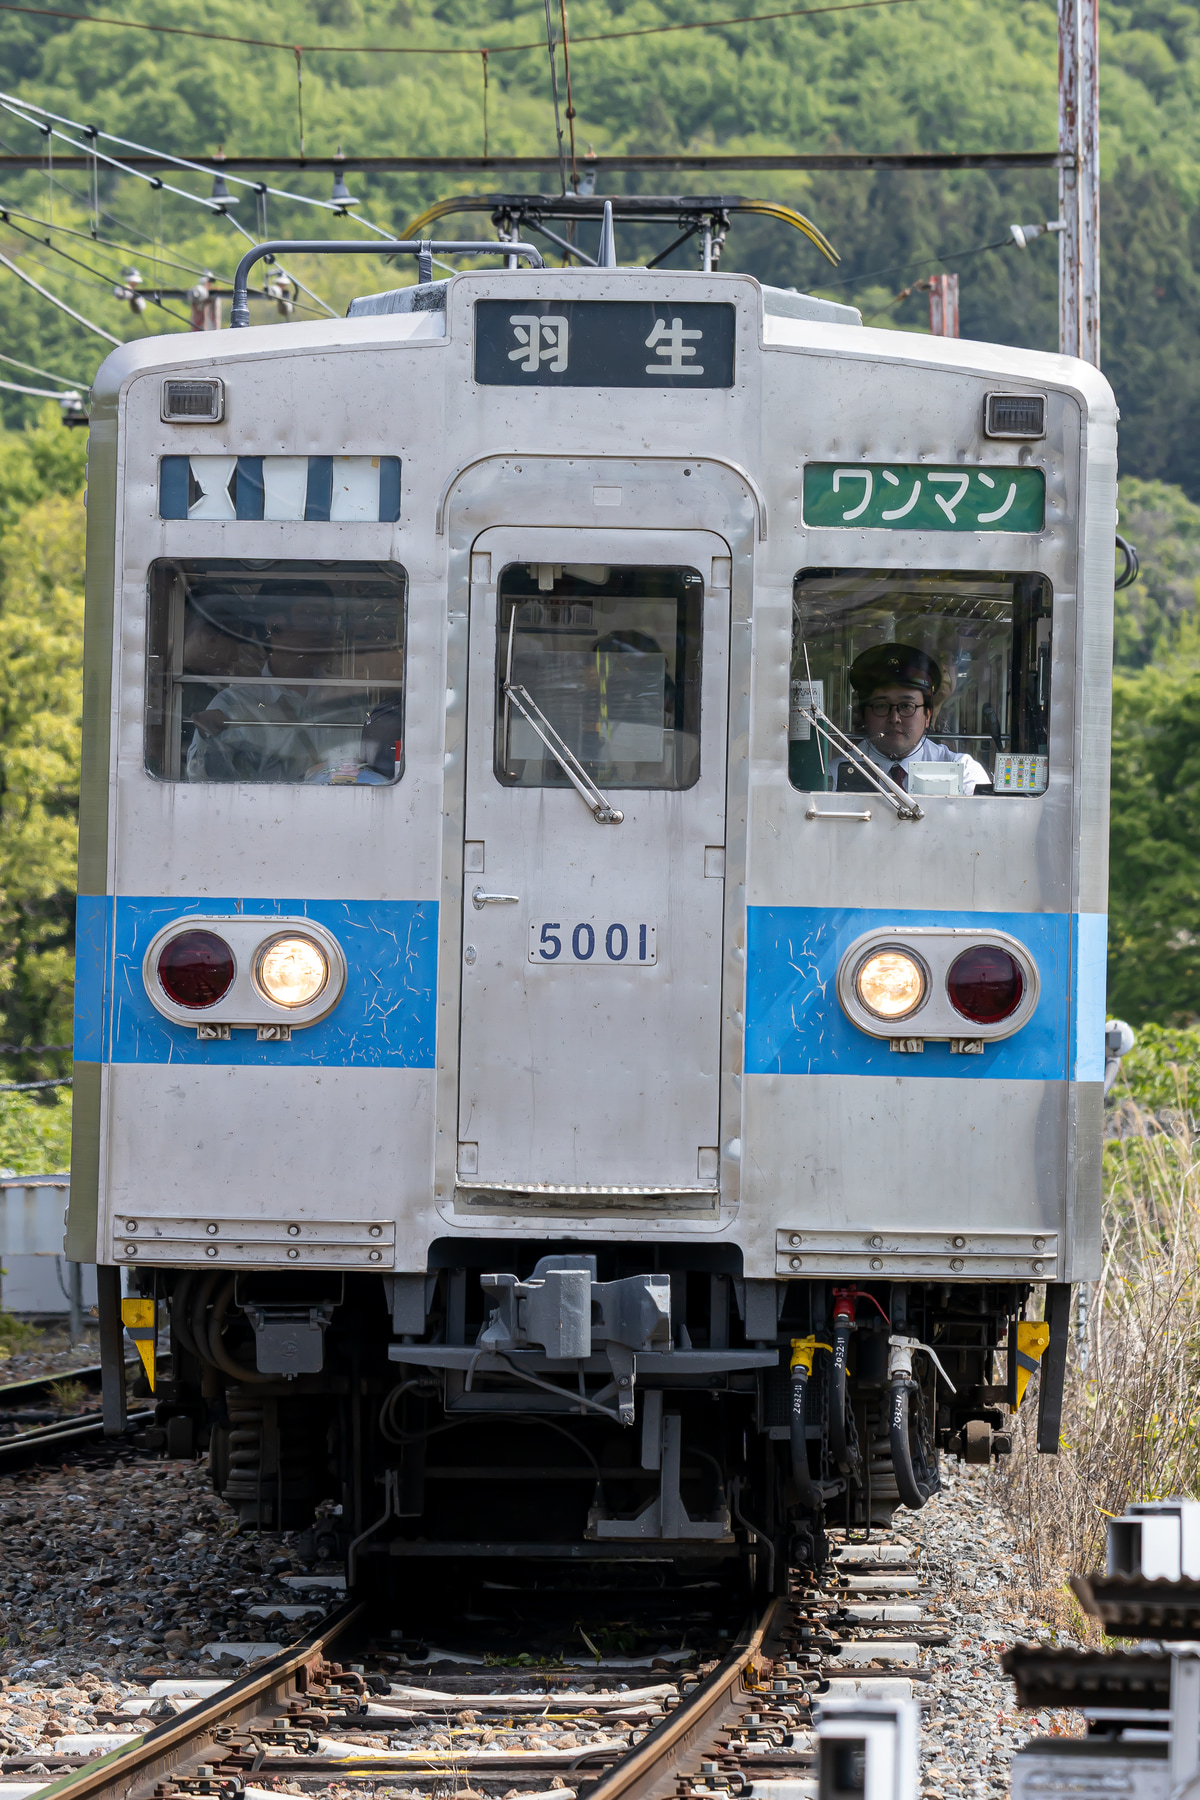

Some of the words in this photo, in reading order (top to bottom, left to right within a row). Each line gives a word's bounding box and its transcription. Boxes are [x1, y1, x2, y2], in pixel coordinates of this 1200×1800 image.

[508, 315, 705, 375] 羽生
[832, 468, 1017, 524] ワンマン
[539, 923, 647, 961] 5001
